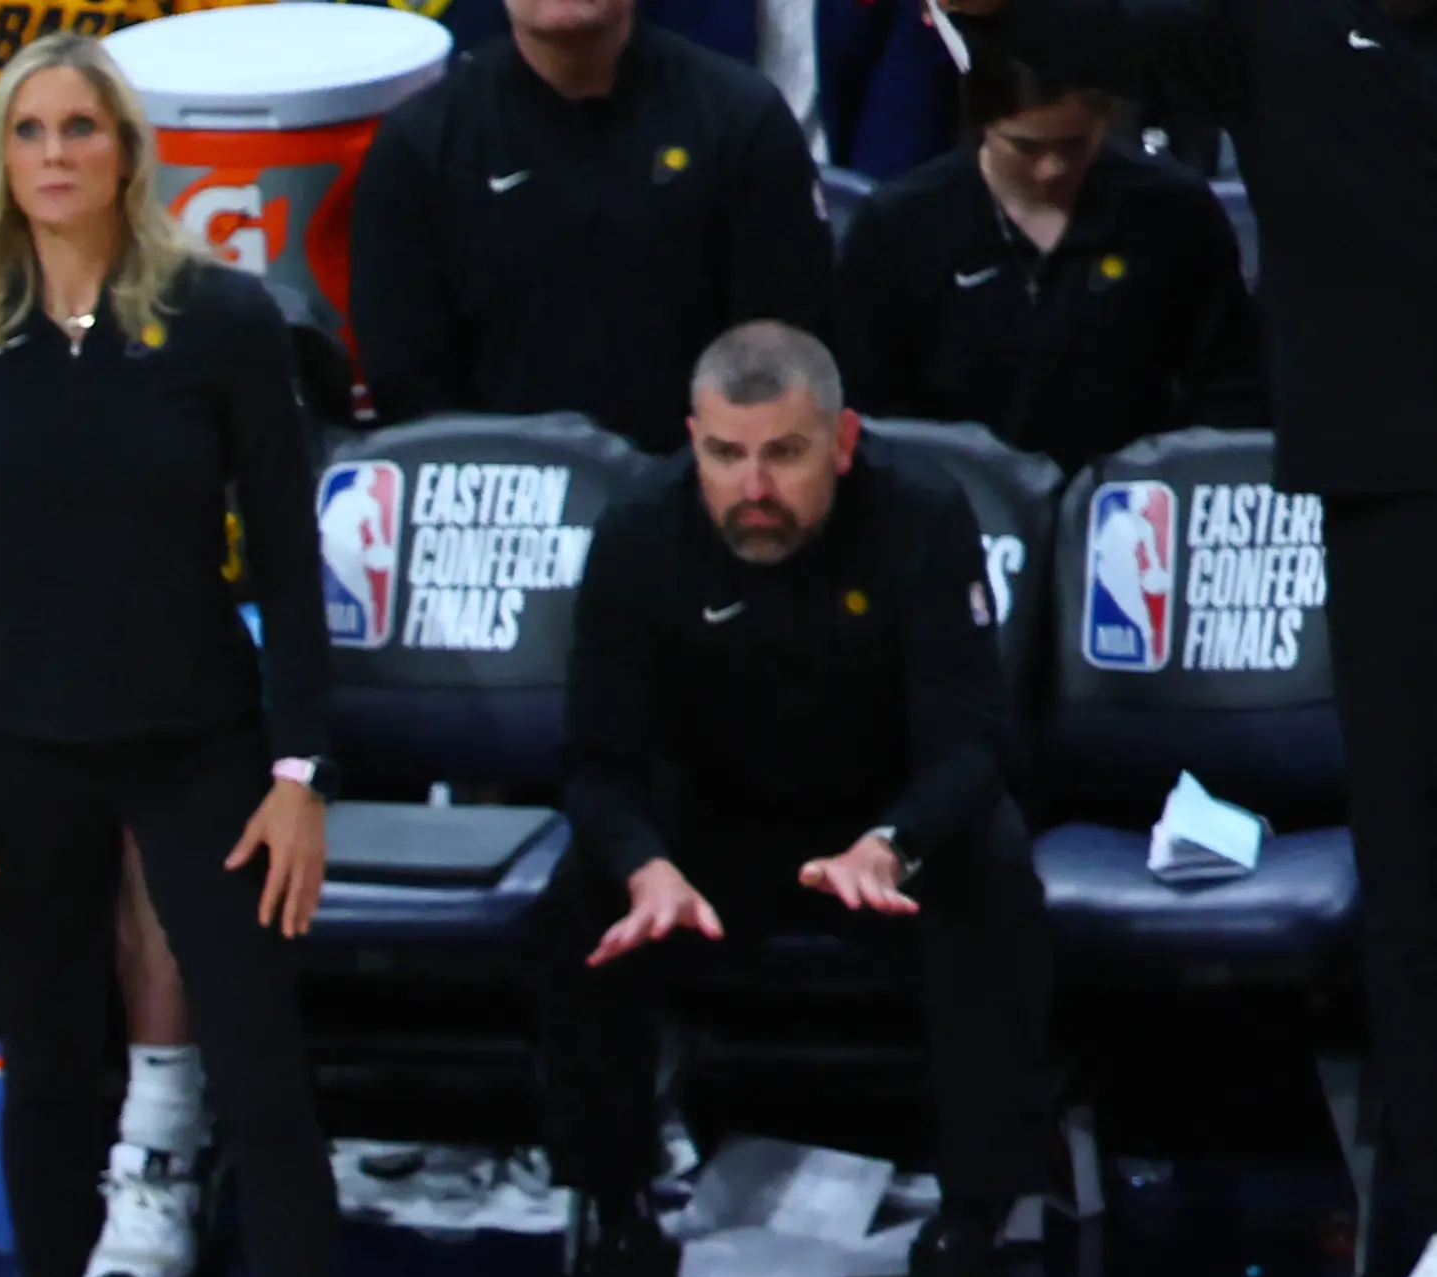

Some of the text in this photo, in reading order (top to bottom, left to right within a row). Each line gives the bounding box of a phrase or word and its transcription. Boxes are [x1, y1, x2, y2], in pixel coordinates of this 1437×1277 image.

[410, 462, 571, 525] EASTERN
[406, 525, 594, 589] CONFEREN
[1186, 546, 1327, 607] CONFER
[401, 587, 526, 651] FINALS
[1182, 606, 1303, 670] FINALS
